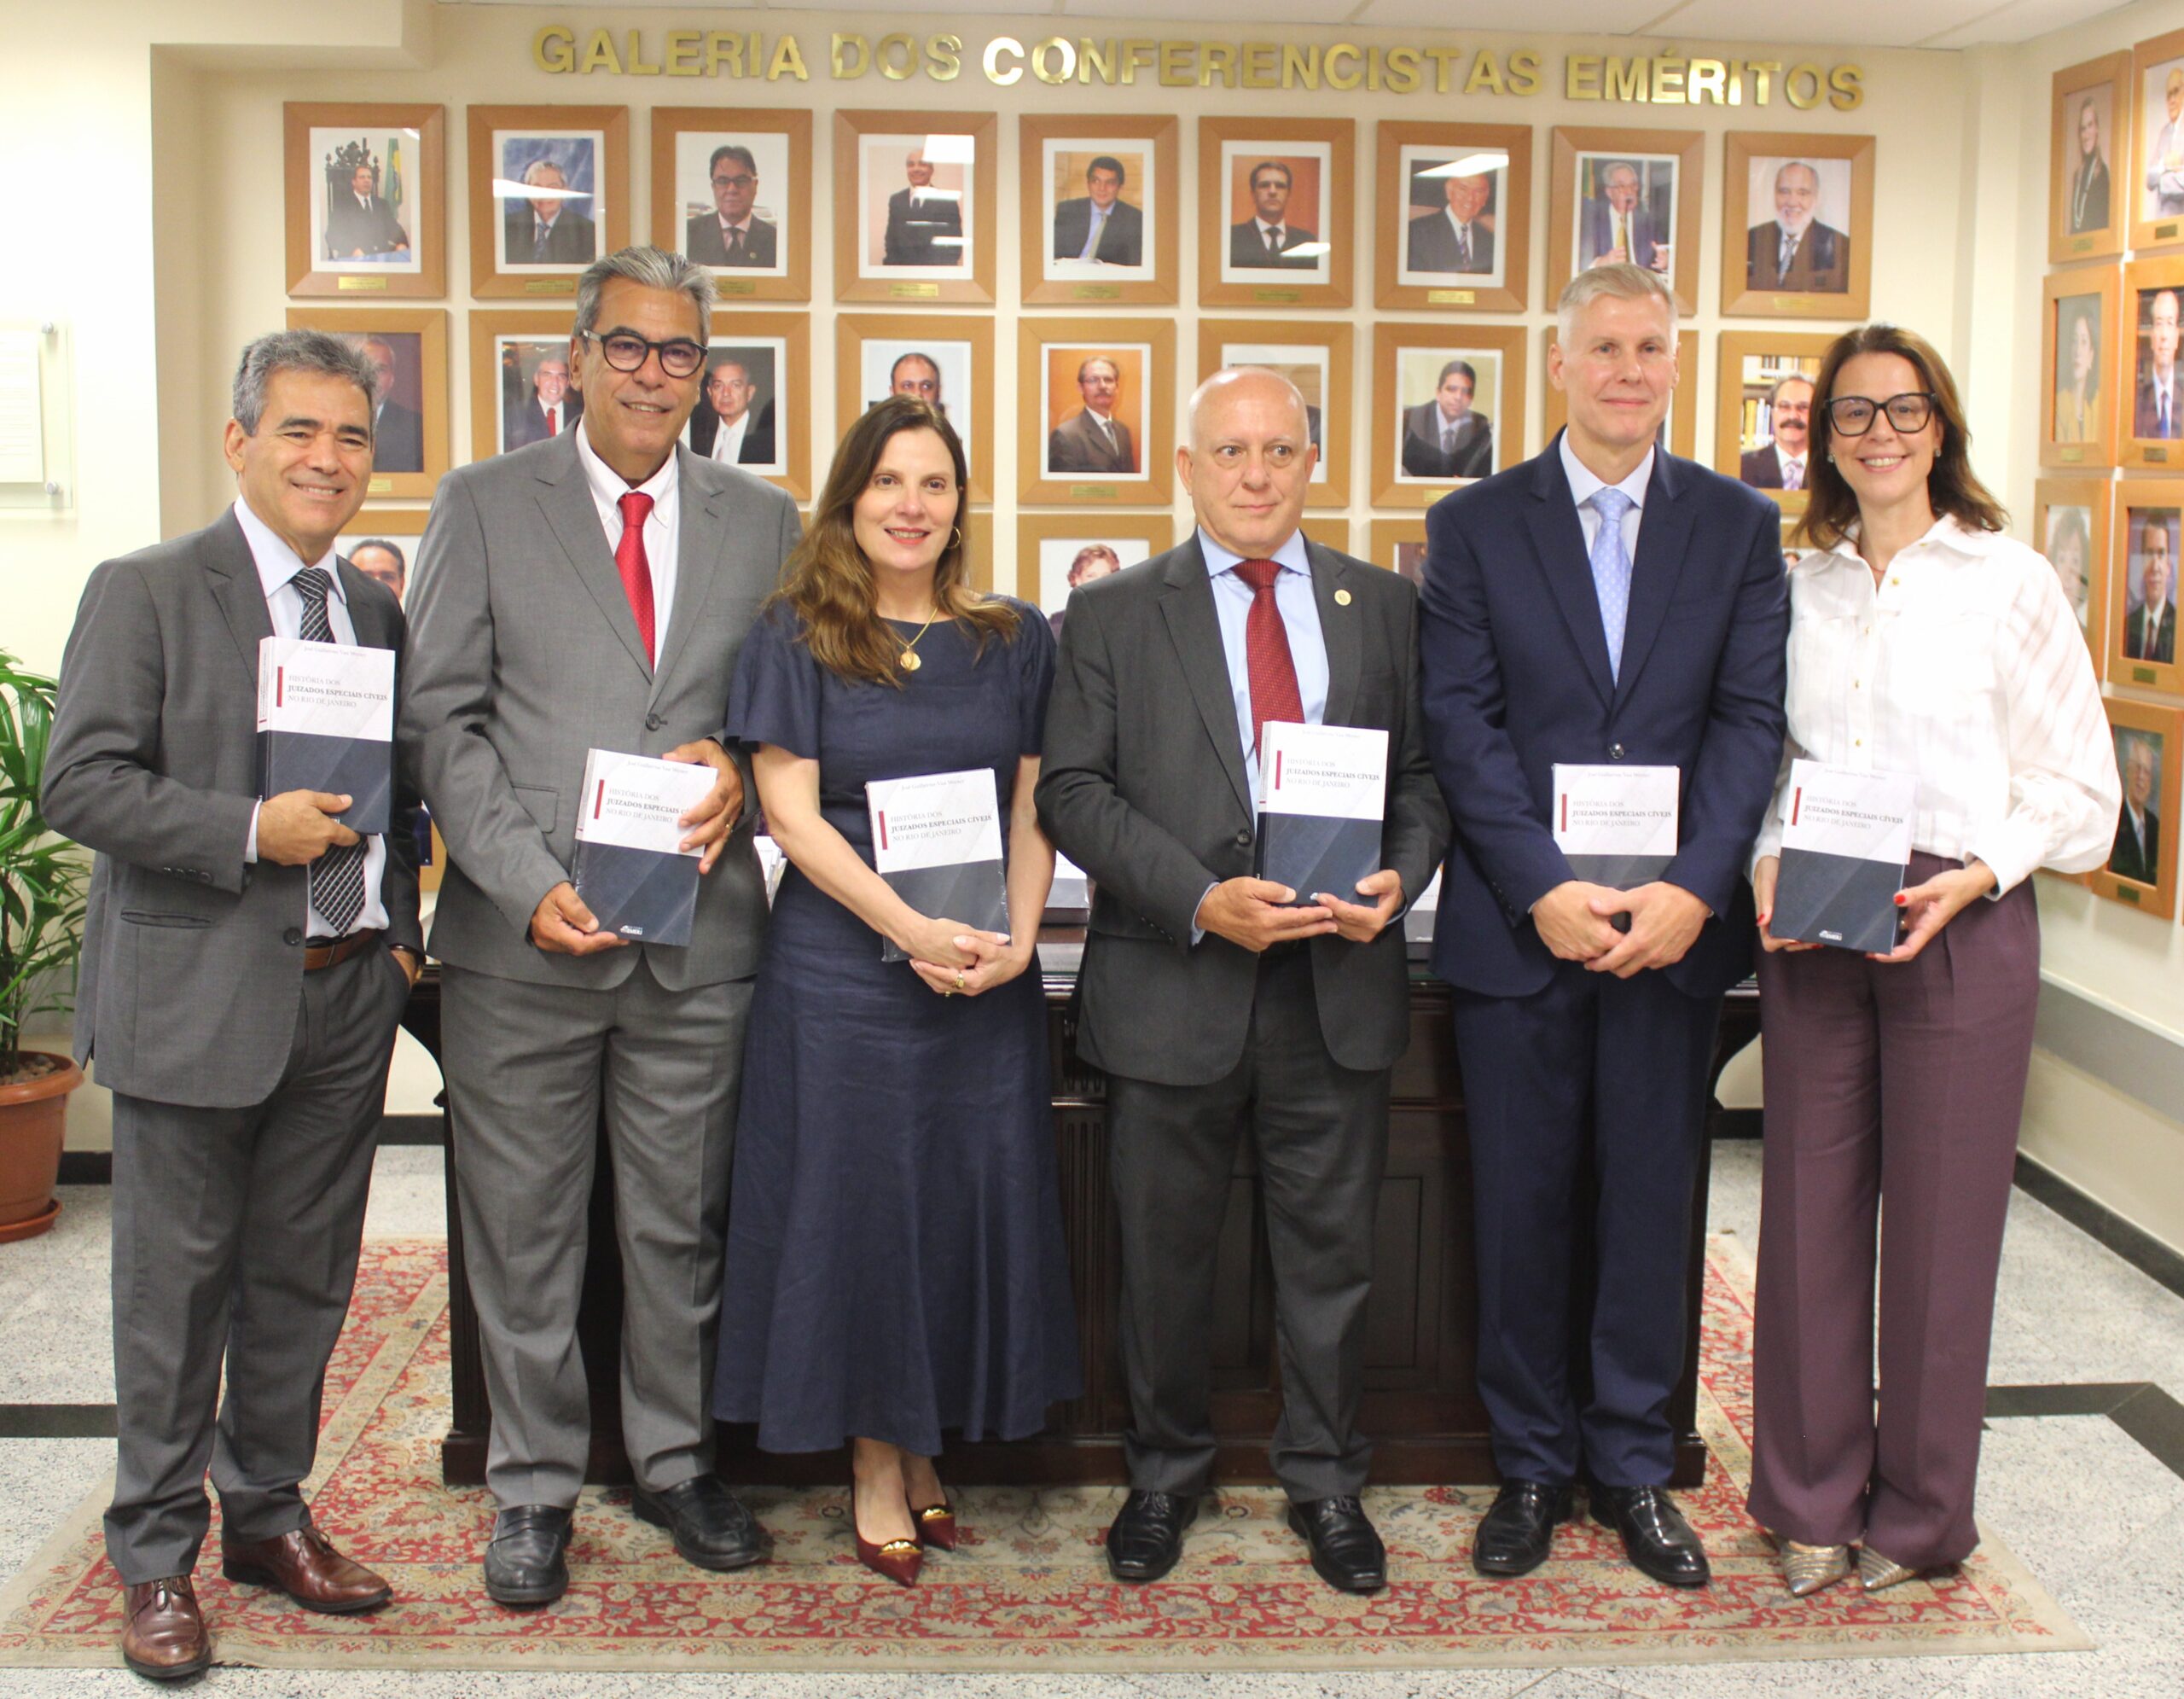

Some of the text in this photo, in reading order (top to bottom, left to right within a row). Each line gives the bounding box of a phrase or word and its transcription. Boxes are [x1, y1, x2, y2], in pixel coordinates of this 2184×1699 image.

[531, 26, 1864, 111] GALERIA DOS CONFERENCISTAS EMÉRITOS
[288, 684, 387, 701] JUIZADOS ESPECIAIS CÍVEIS
[326, 698, 357, 707] JANEIRO
[1356, 771, 1380, 781] CÍVEIS
[607, 798, 642, 808] JUIZADOS
[643, 803, 679, 813] ESPECIAIS
[642, 812, 672, 823] JANEIRO
[1647, 810, 1672, 818] CÍVEIS
[1804, 805, 1903, 824] JUIZADOS ESPECIAIS CÍVEIS
[892, 814, 991, 833] JUIZADOS ESPECIAIS CÍVEIS
[930, 828, 961, 839] JANEIRO
